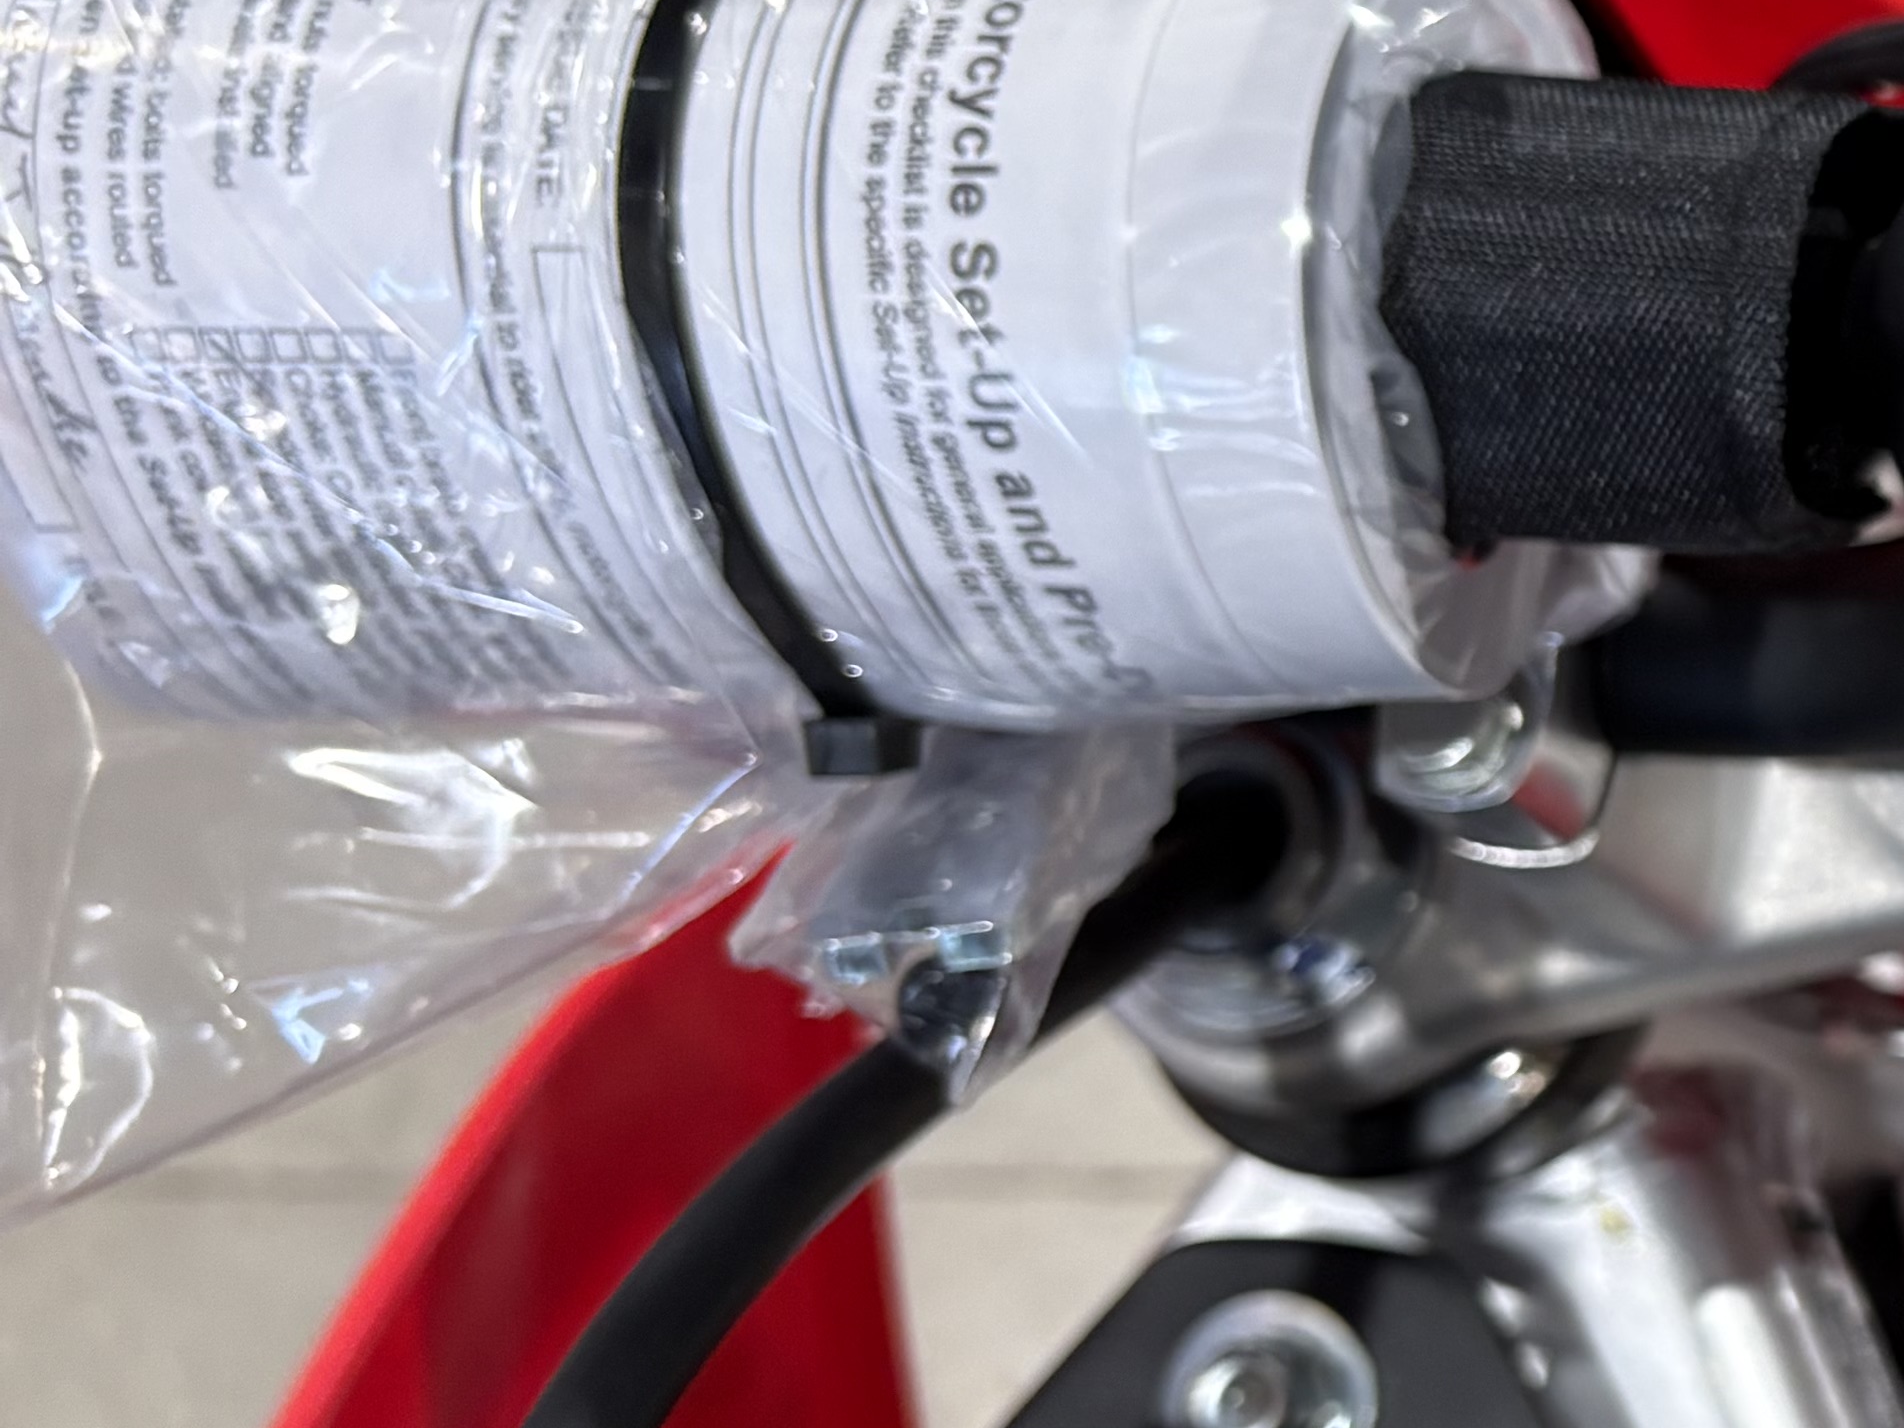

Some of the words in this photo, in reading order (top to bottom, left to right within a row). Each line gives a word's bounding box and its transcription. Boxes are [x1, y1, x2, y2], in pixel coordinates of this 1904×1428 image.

[923, 17, 961, 59] this
[105, 82, 137, 164] wires
[141, 91, 174, 165] bolts
[281, 63, 319, 178] torqued
[864, 122, 898, 167] the
[873, 83, 906, 111] to
[901, 68, 942, 196] checklist
[55, 53, 95, 156] et-up
[112, 396, 149, 447] the
[107, 170, 140, 270] routed
[139, 171, 177, 289] torqued
[858, 178, 895, 294] specific
[901, 203, 929, 231] is
[872, 301, 913, 404] Set-Up
[901, 239, 942, 379] designed
[923, 387, 955, 426] for
[948, 240, 1021, 453] Set-Up
[993, 471, 1076, 569] and
[894, 412, 970, 562] Instructions
[931, 433, 995, 533] general
